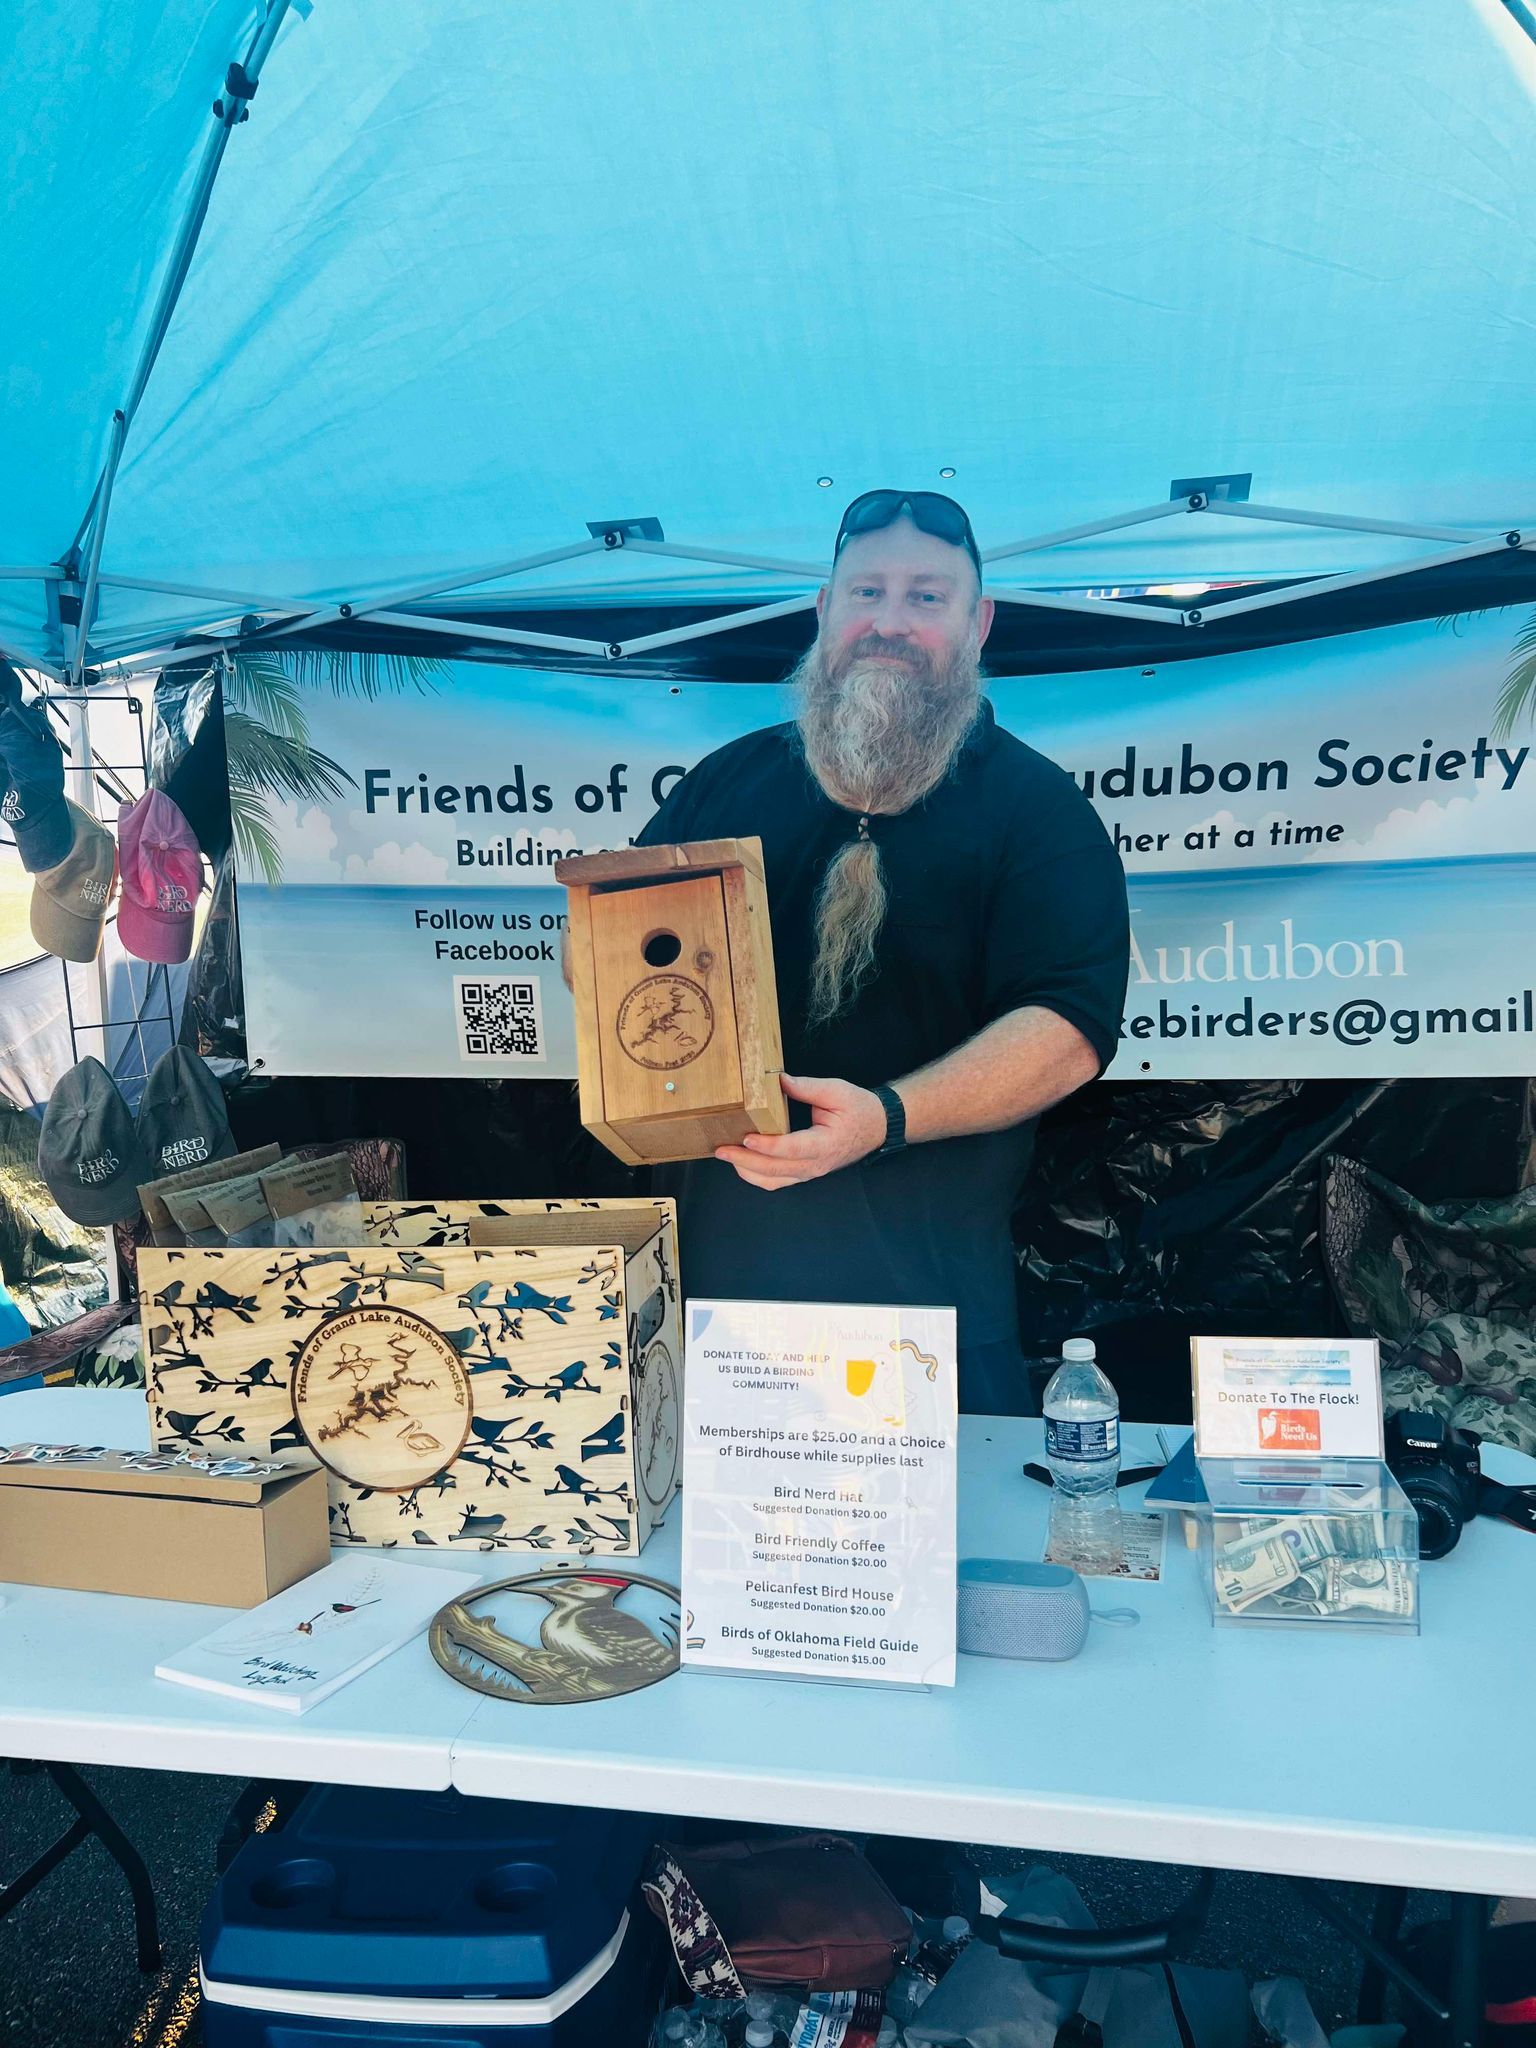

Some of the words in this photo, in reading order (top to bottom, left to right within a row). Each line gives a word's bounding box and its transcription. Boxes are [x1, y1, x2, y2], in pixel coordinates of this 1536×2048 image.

[1069, 744, 1289, 799] udubon
[1314, 737, 1530, 790] Society
[365, 764, 554, 814] Friends
[575, 763, 628, 812] of
[1114, 823, 1170, 853] her
[1184, 825, 1219, 850] at
[1235, 830, 1254, 847] a
[1270, 820, 1344, 845] time
[84, 879, 108, 894] BIR
[80, 889, 106, 904] NER
[415, 908, 495, 930] Follow
[502, 912, 532, 931] us
[435, 940, 554, 961] Facebook
[162, 1136, 205, 1157] BIRD
[162, 1148, 208, 1169] NERD
[80, 1158, 119, 1184] NERD
[298, 1354, 314, 1403] Friends
[312, 1342, 324, 1353] of
[321, 1315, 357, 1341] Grand
[359, 1312, 390, 1323] Lake
[394, 1315, 445, 1355] Audubon
[444, 1355, 465, 1407] Society
[704, 1350, 743, 1360] DONATE
[783, 1354, 804, 1362] AND
[719, 1365, 731, 1373] US
[734, 1366, 761, 1374] BUILD
[764, 1367, 770, 1375] A
[773, 1367, 814, 1376] BIRDING
[733, 1380, 799, 1390] COMMUNITY!
[1218, 1392, 1267, 1403] Donate
[1270, 1393, 1286, 1404] To
[1290, 1393, 1315, 1404] The
[1320, 1393, 1359, 1404] Flock!
[699, 1425, 784, 1442] Memberships
[789, 1431, 808, 1442] are
[812, 1430, 857, 1445] $25.00
[861, 1434, 885, 1446] and
[900, 1436, 946, 1449] Choice
[1281, 1424, 1305, 1432] Birds
[1281, 1432, 1304, 1440] Need
[1305, 1432, 1317, 1440] Us
[1407, 1439, 1438, 1449] Canon
[719, 1446, 732, 1457] of
[735, 1445, 800, 1460] Birdhouse
[804, 1449, 838, 1463] while
[841, 1453, 896, 1468] supplies
[900, 1455, 924, 1467] last
[774, 1486, 800, 1499] Bird
[805, 1488, 836, 1501] Nerd
[840, 1490, 863, 1503] Hat
[753, 1503, 803, 1517] Suggested
[805, 1506, 849, 1518] Donation
[852, 1508, 887, 1520] $20.00
[755, 1533, 781, 1546] Bird
[785, 1534, 838, 1551] Friendly
[842, 1538, 886, 1552] Coffee
[752, 1550, 802, 1565] Suggested
[805, 1554, 849, 1566] Donation
[852, 1556, 887, 1569] $20.00
[746, 1580, 818, 1597] Pelicanfest
[822, 1585, 847, 1598] Bird
[852, 1587, 894, 1601] House
[1225, 1578, 1243, 1597] 10
[750, 1598, 800, 1612] Suggested
[803, 1602, 847, 1614] Donation
[850, 1605, 886, 1617] $20.00
[721, 1626, 754, 1640] Birds
[758, 1629, 771, 1641] of
[774, 1630, 840, 1646] Oklahoma
[844, 1635, 876, 1649] Field
[880, 1639, 919, 1653] Guide
[752, 1647, 801, 1661] Suggested
[803, 1650, 849, 1663] Donation
[851, 1654, 886, 1666] $15.00
